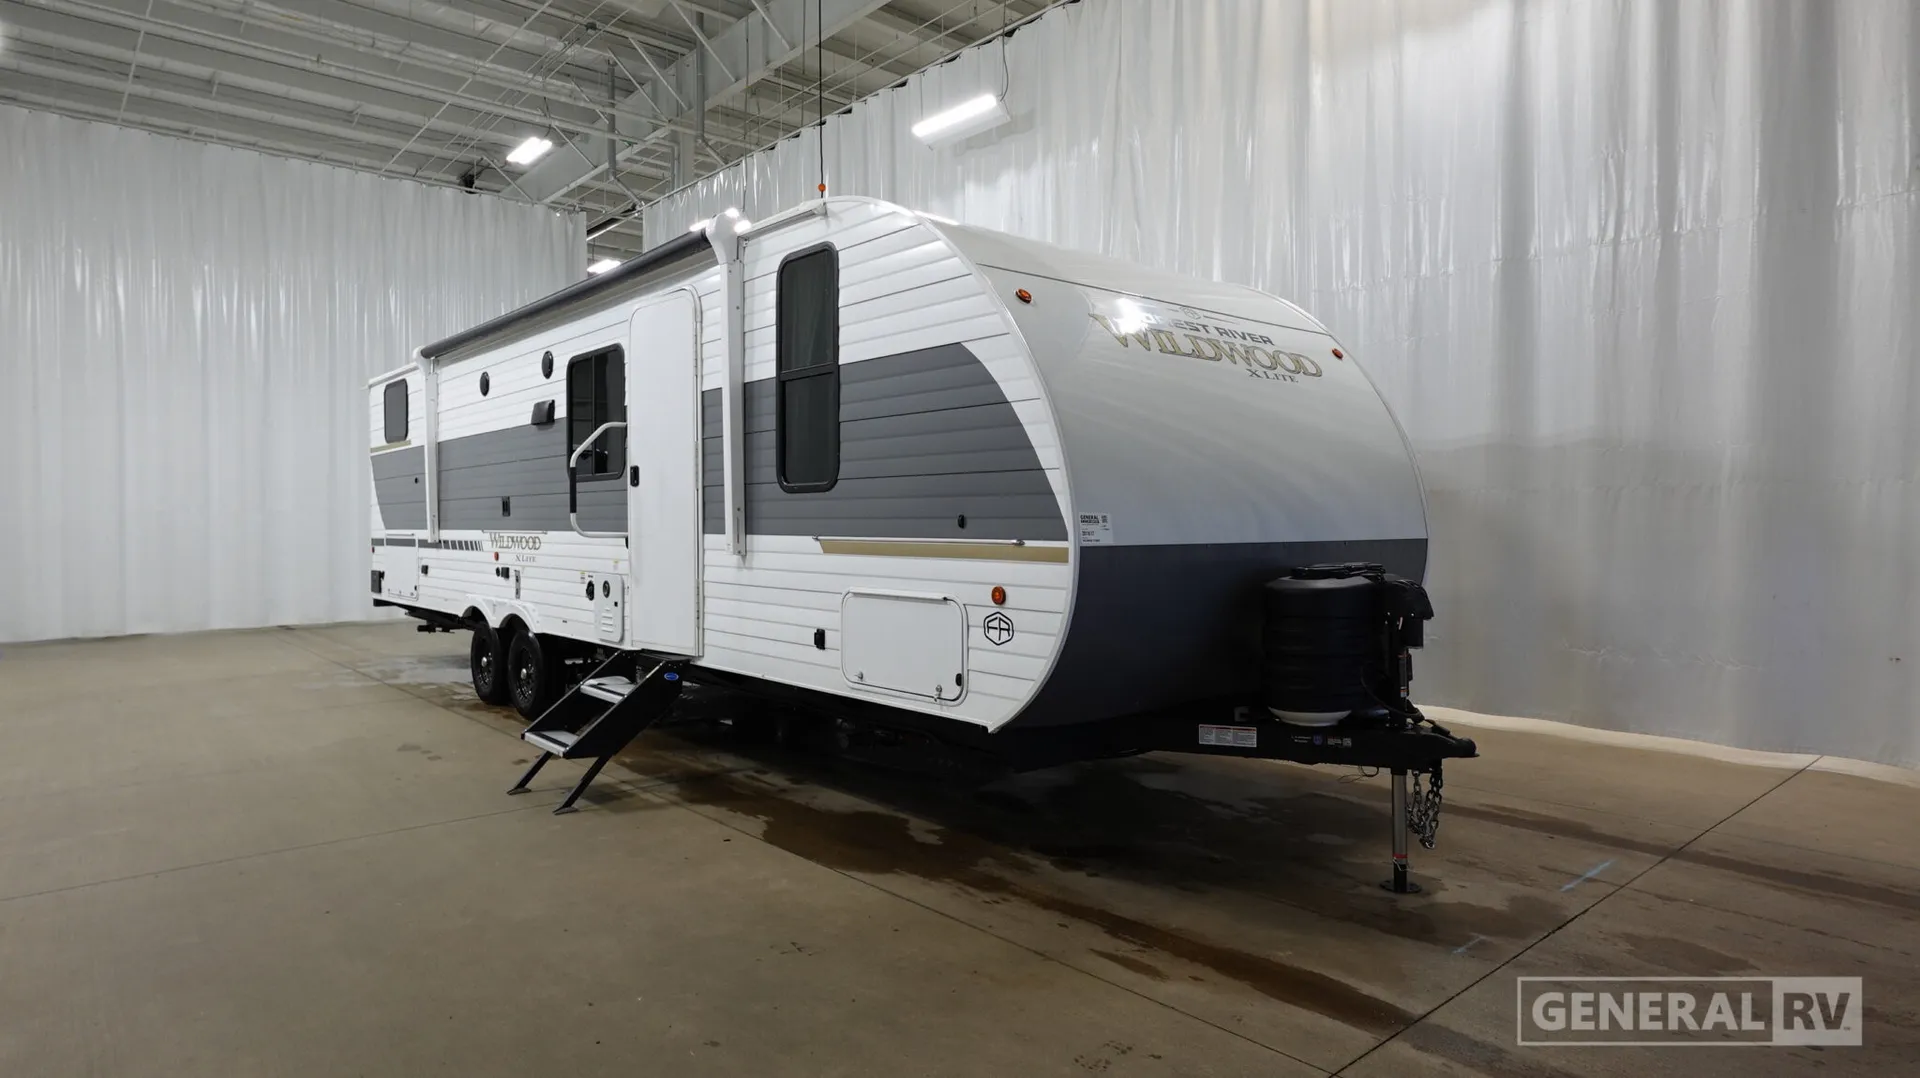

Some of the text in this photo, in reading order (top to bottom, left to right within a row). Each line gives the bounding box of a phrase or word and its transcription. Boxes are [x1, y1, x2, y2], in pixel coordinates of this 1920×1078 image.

[1088, 313, 1323, 378] WILDWOOD
[1213, 326, 1275, 346] RIVER
[490, 532, 541, 550] WILDWOOD
